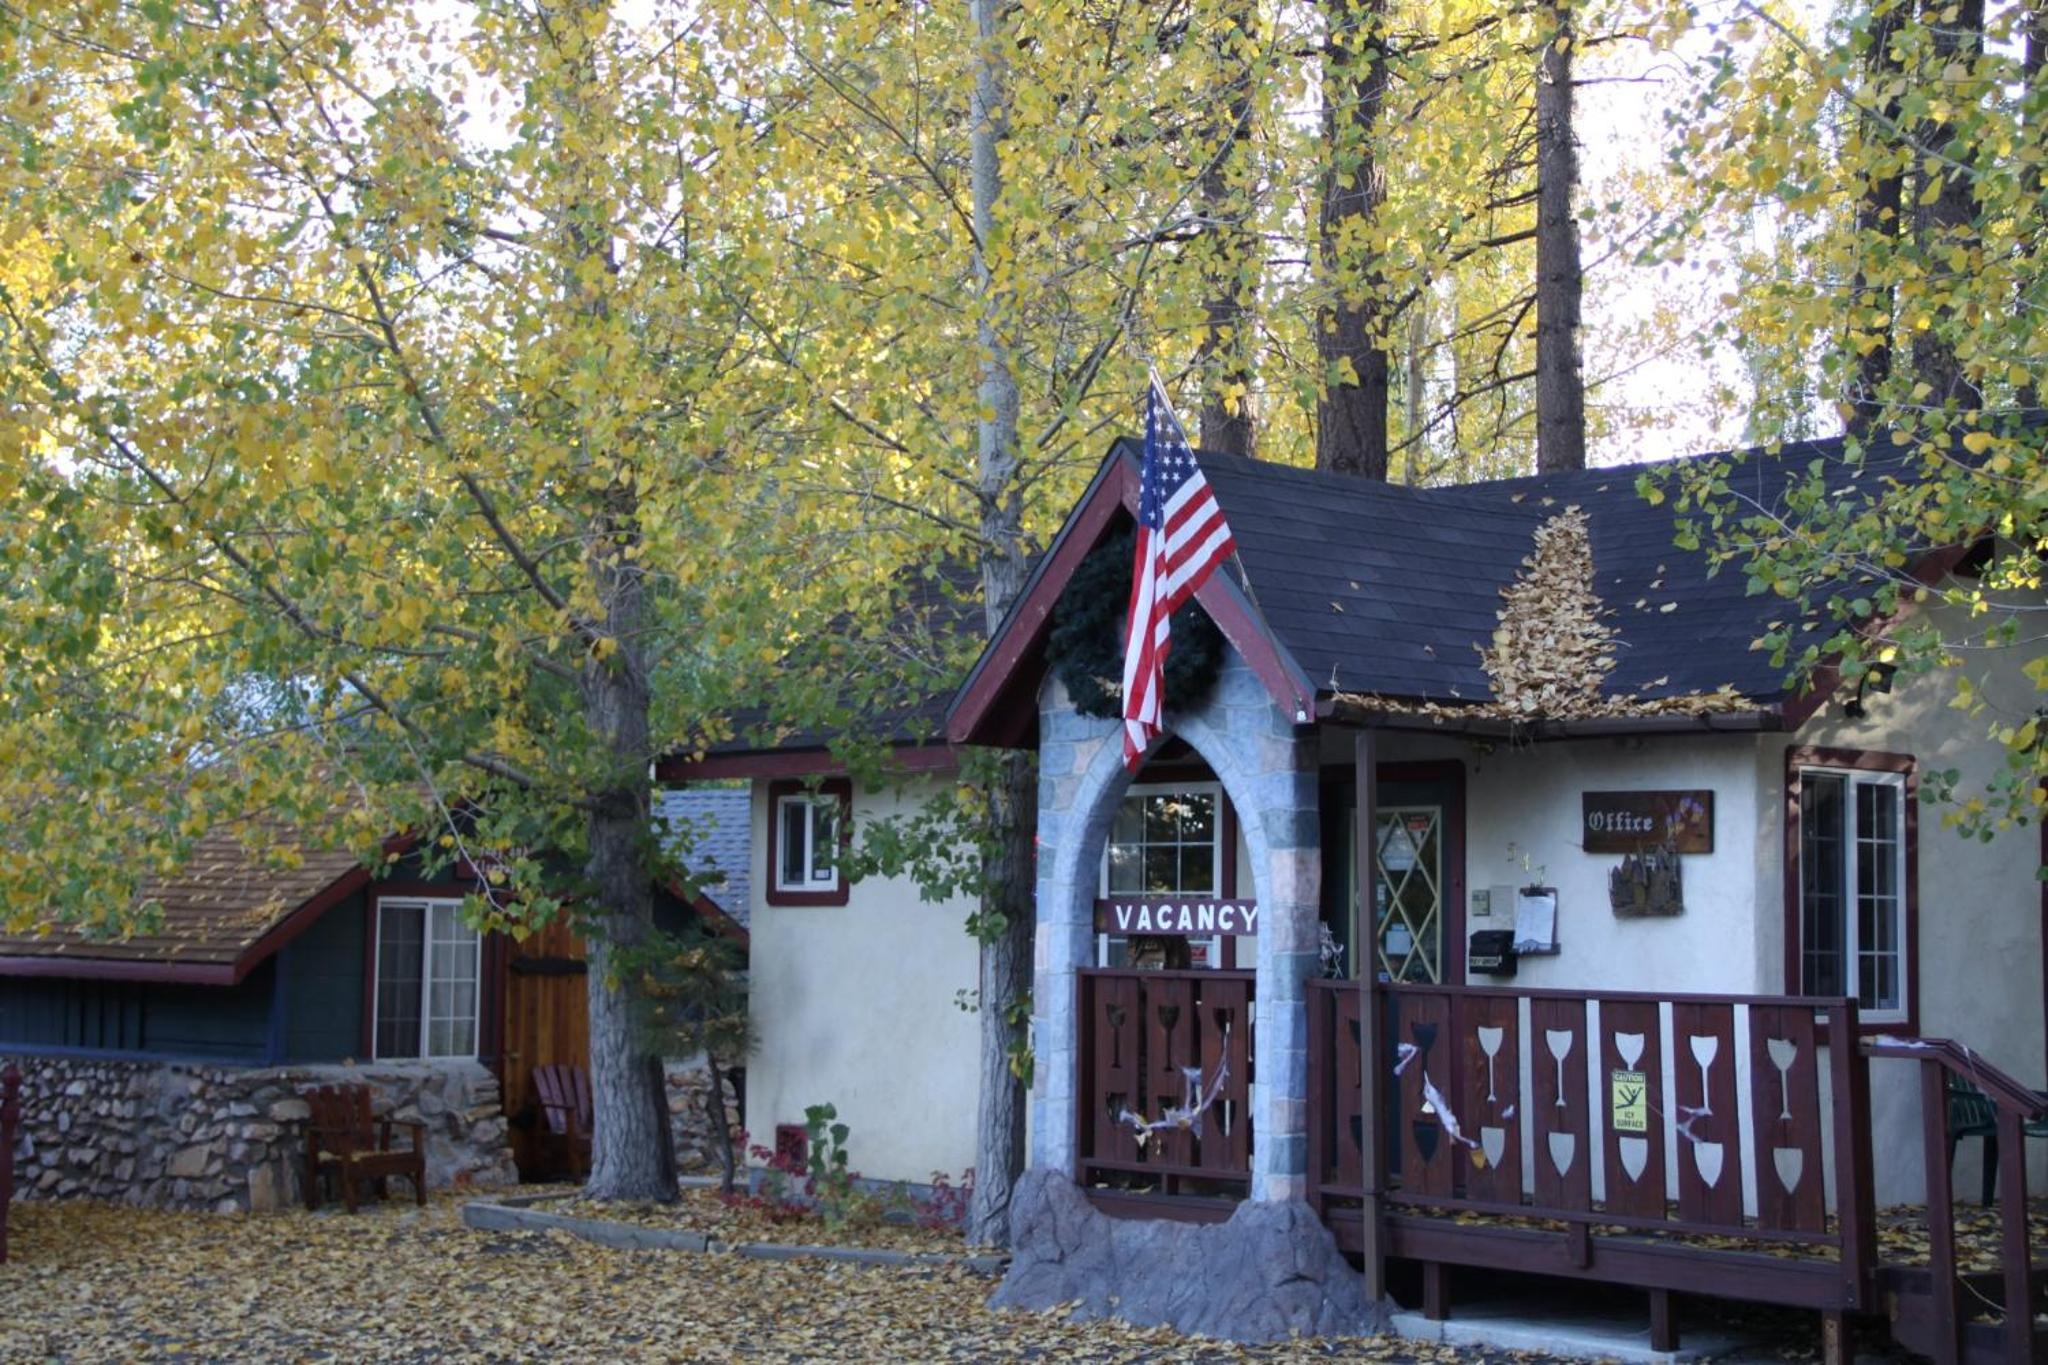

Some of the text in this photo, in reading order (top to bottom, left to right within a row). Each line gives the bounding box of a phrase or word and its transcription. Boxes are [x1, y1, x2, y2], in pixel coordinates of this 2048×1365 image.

[1588, 811, 1654, 832] Office
[1115, 904, 1258, 932] VACANCY
[1624, 1111, 1635, 1119] ICY
